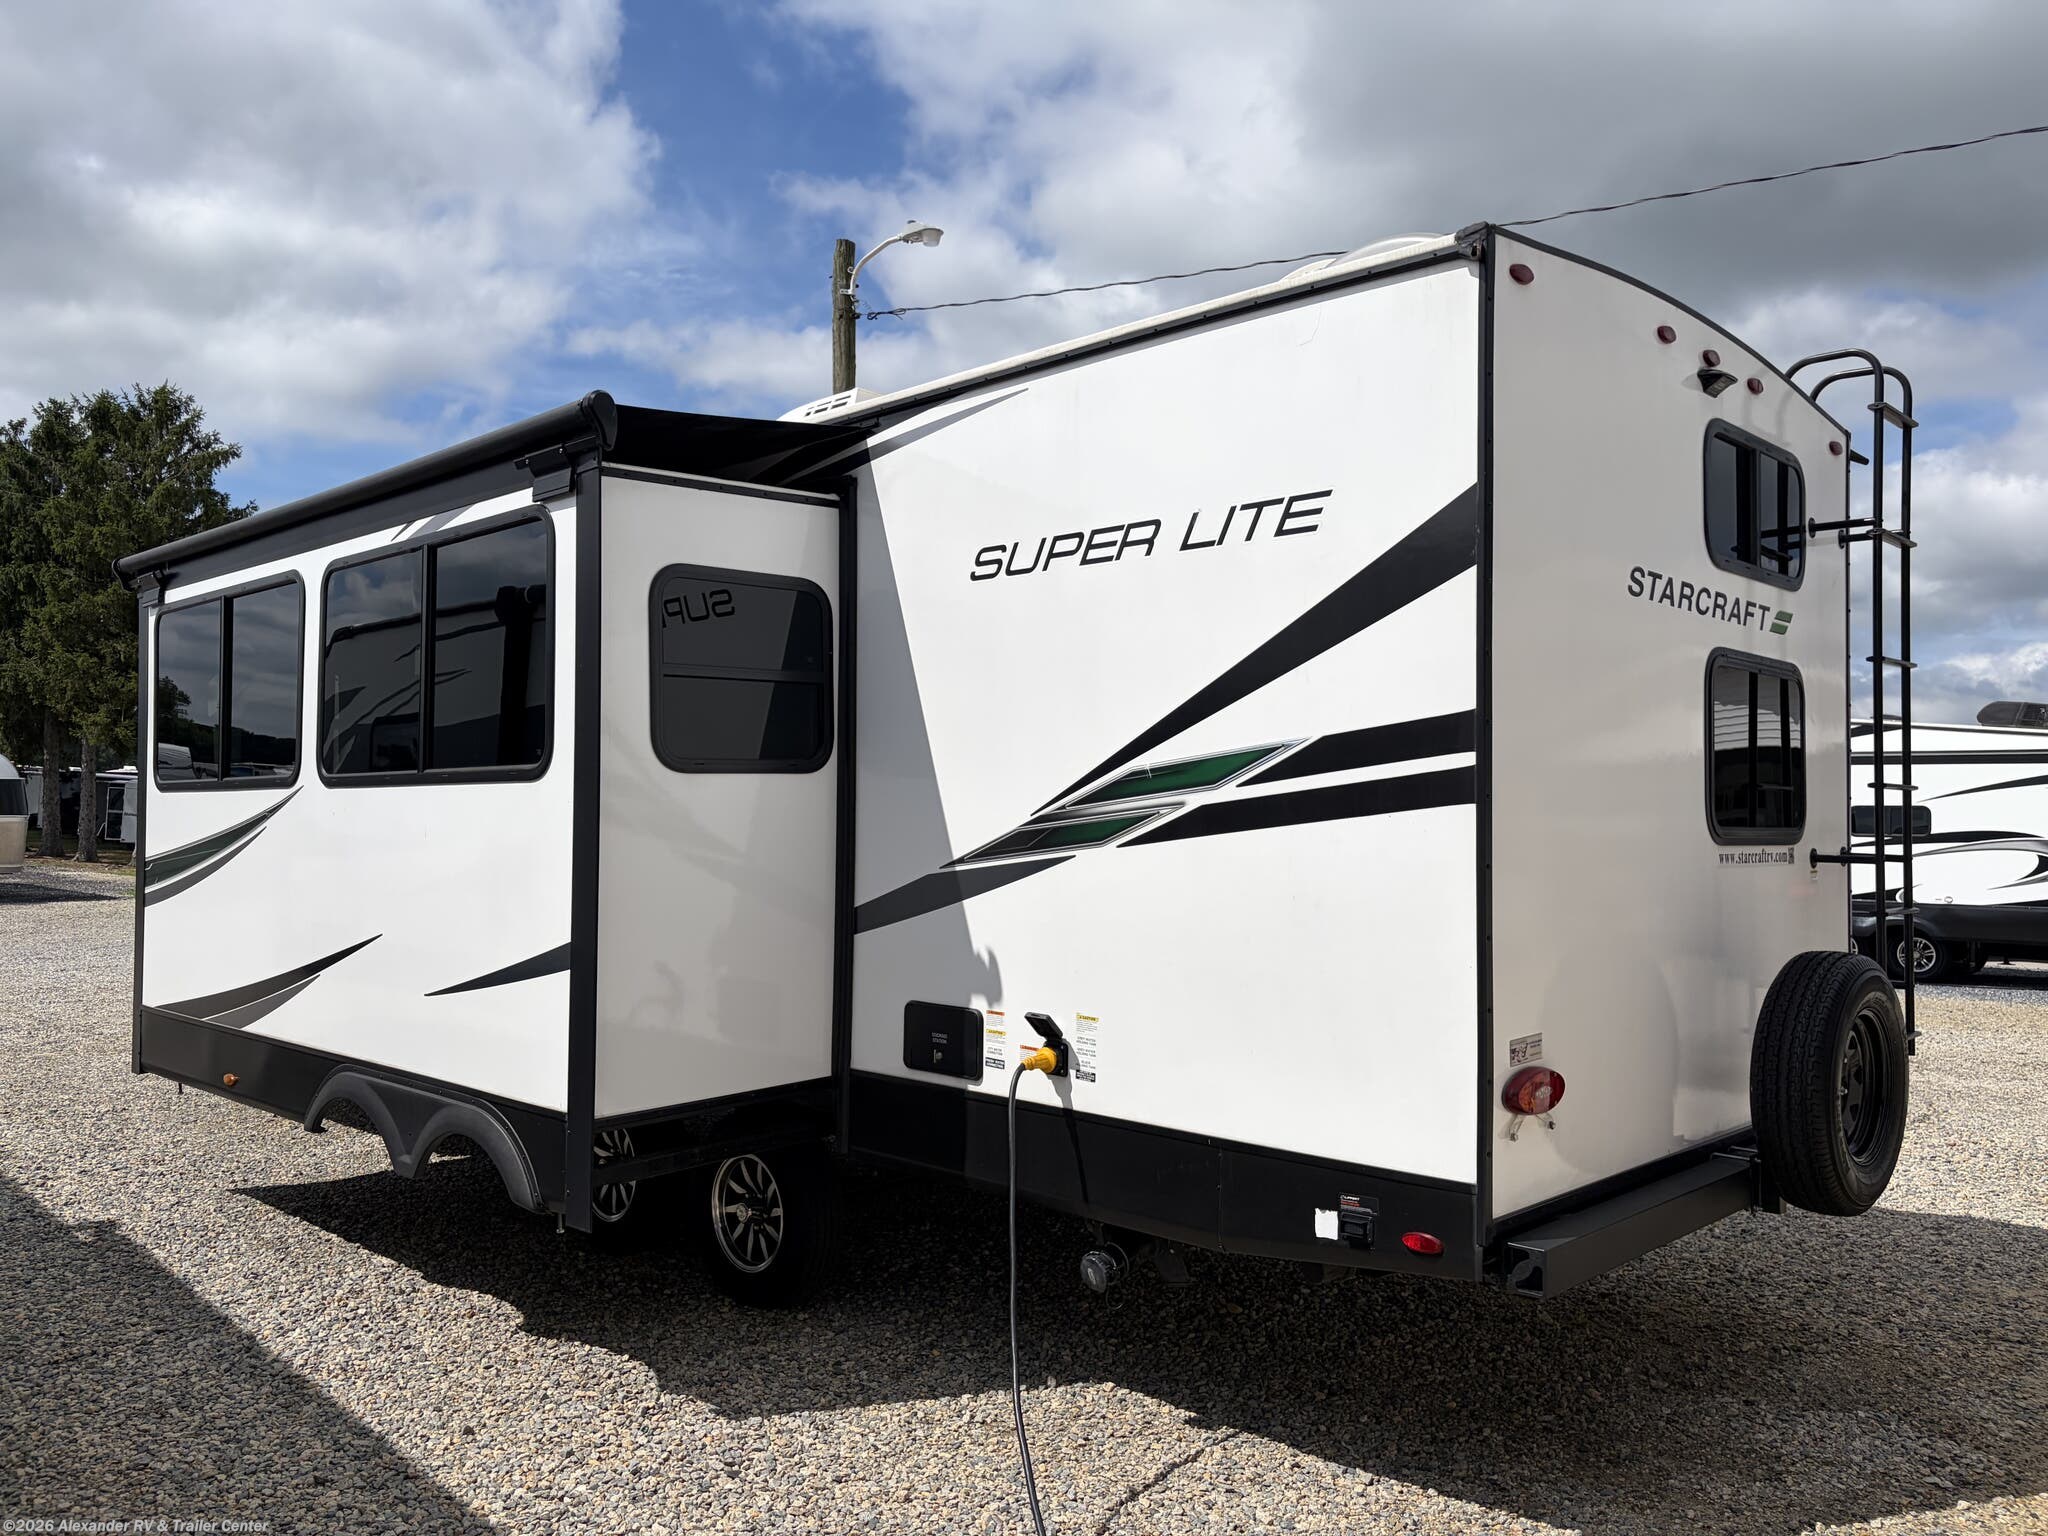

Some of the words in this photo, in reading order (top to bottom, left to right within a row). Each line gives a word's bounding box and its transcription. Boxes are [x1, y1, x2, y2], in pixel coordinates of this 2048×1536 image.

[970, 518, 1162, 582] SUPER
[1179, 489, 1334, 552] LITE
[1627, 566, 1771, 631] STARCRAFT
[1719, 847, 1788, 865] www.starcraftrv.com
